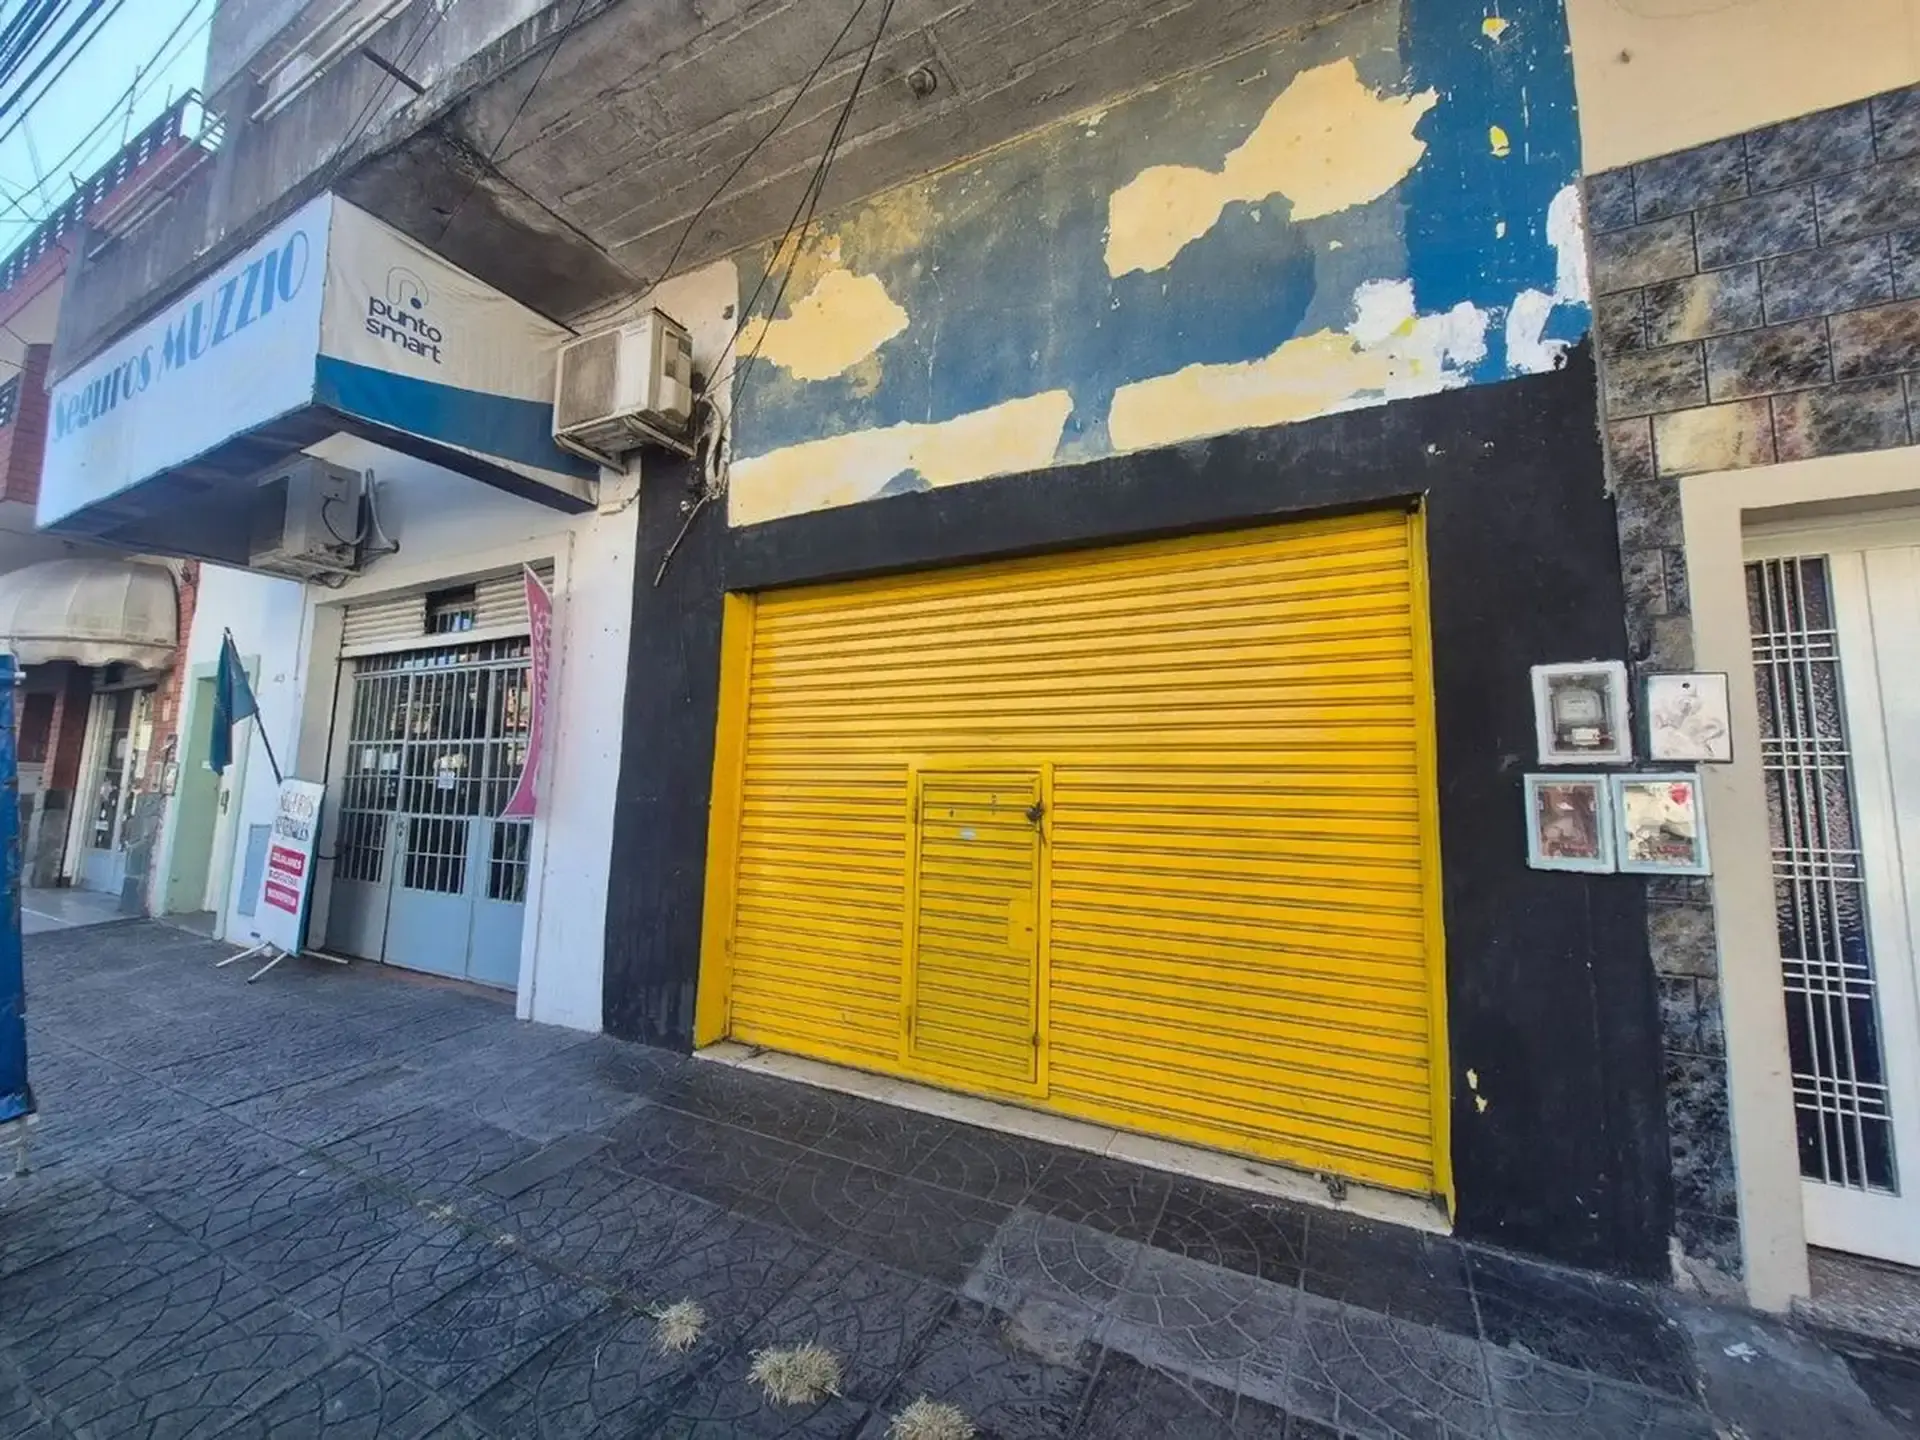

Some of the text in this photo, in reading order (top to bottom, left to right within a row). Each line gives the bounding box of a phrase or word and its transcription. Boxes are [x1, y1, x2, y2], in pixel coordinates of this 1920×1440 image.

[53, 229, 310, 443] Seguros MUZZIO
[366, 318, 442, 364] smart
[368, 296, 442, 343] punto
